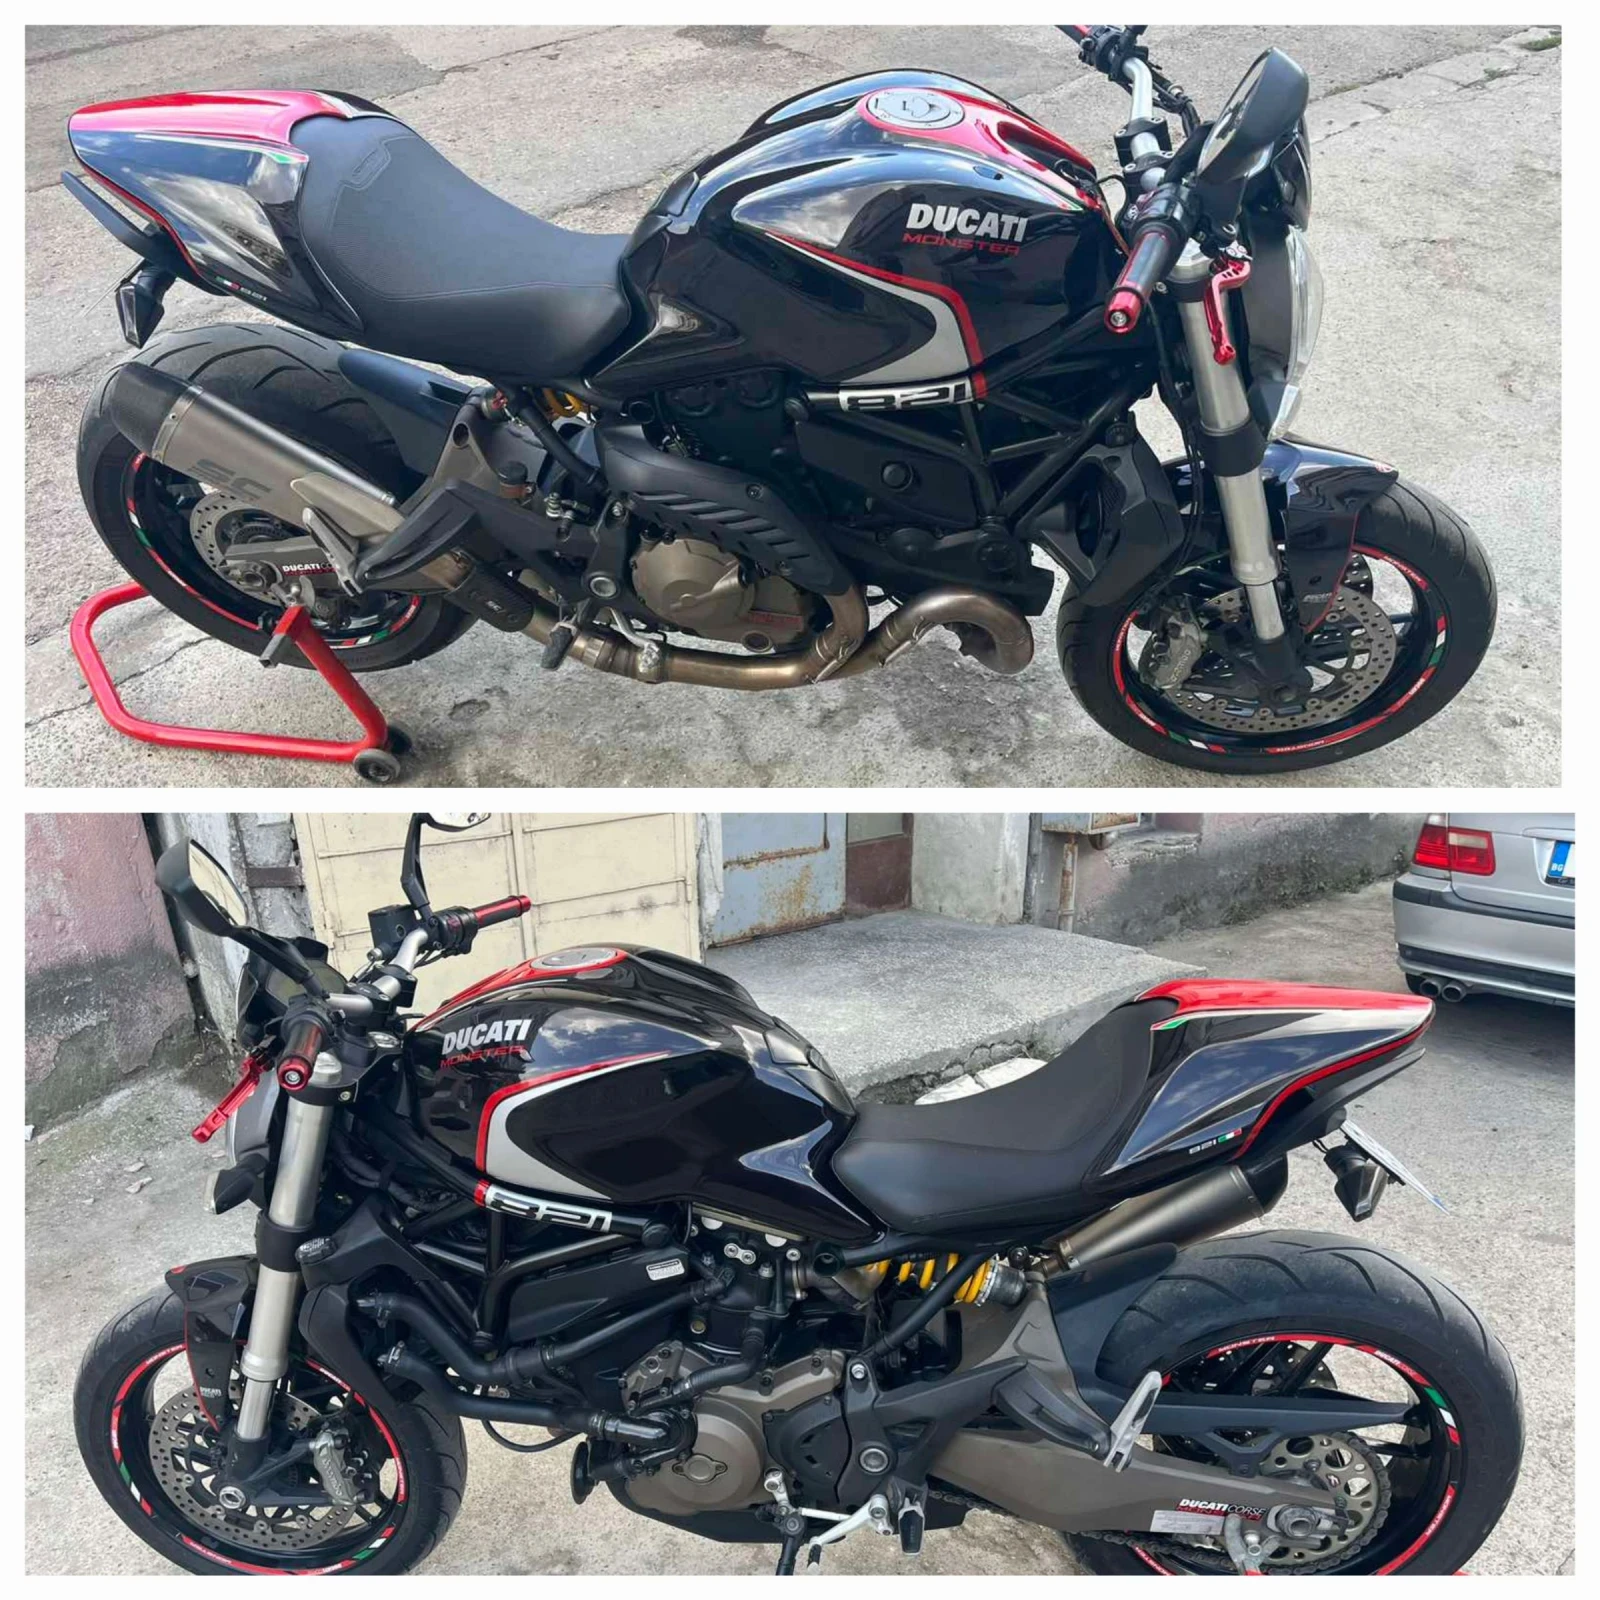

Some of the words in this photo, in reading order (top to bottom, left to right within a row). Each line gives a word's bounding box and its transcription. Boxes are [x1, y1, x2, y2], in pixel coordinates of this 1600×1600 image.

[905, 203, 1029, 242] DUCATI
[902, 232, 1021, 256] MONSTER
[845, 379, 969, 411] 821
[282, 563, 320, 572] DUCATI
[1551, 862, 1564, 872] BG
[441, 1019, 532, 1055] DUCATI
[440, 1044, 526, 1069] MONSTER
[490, 1191, 608, 1232] 821
[1179, 1499, 1228, 1511] DUCATI
[1227, 1504, 1266, 1516] CORSE
